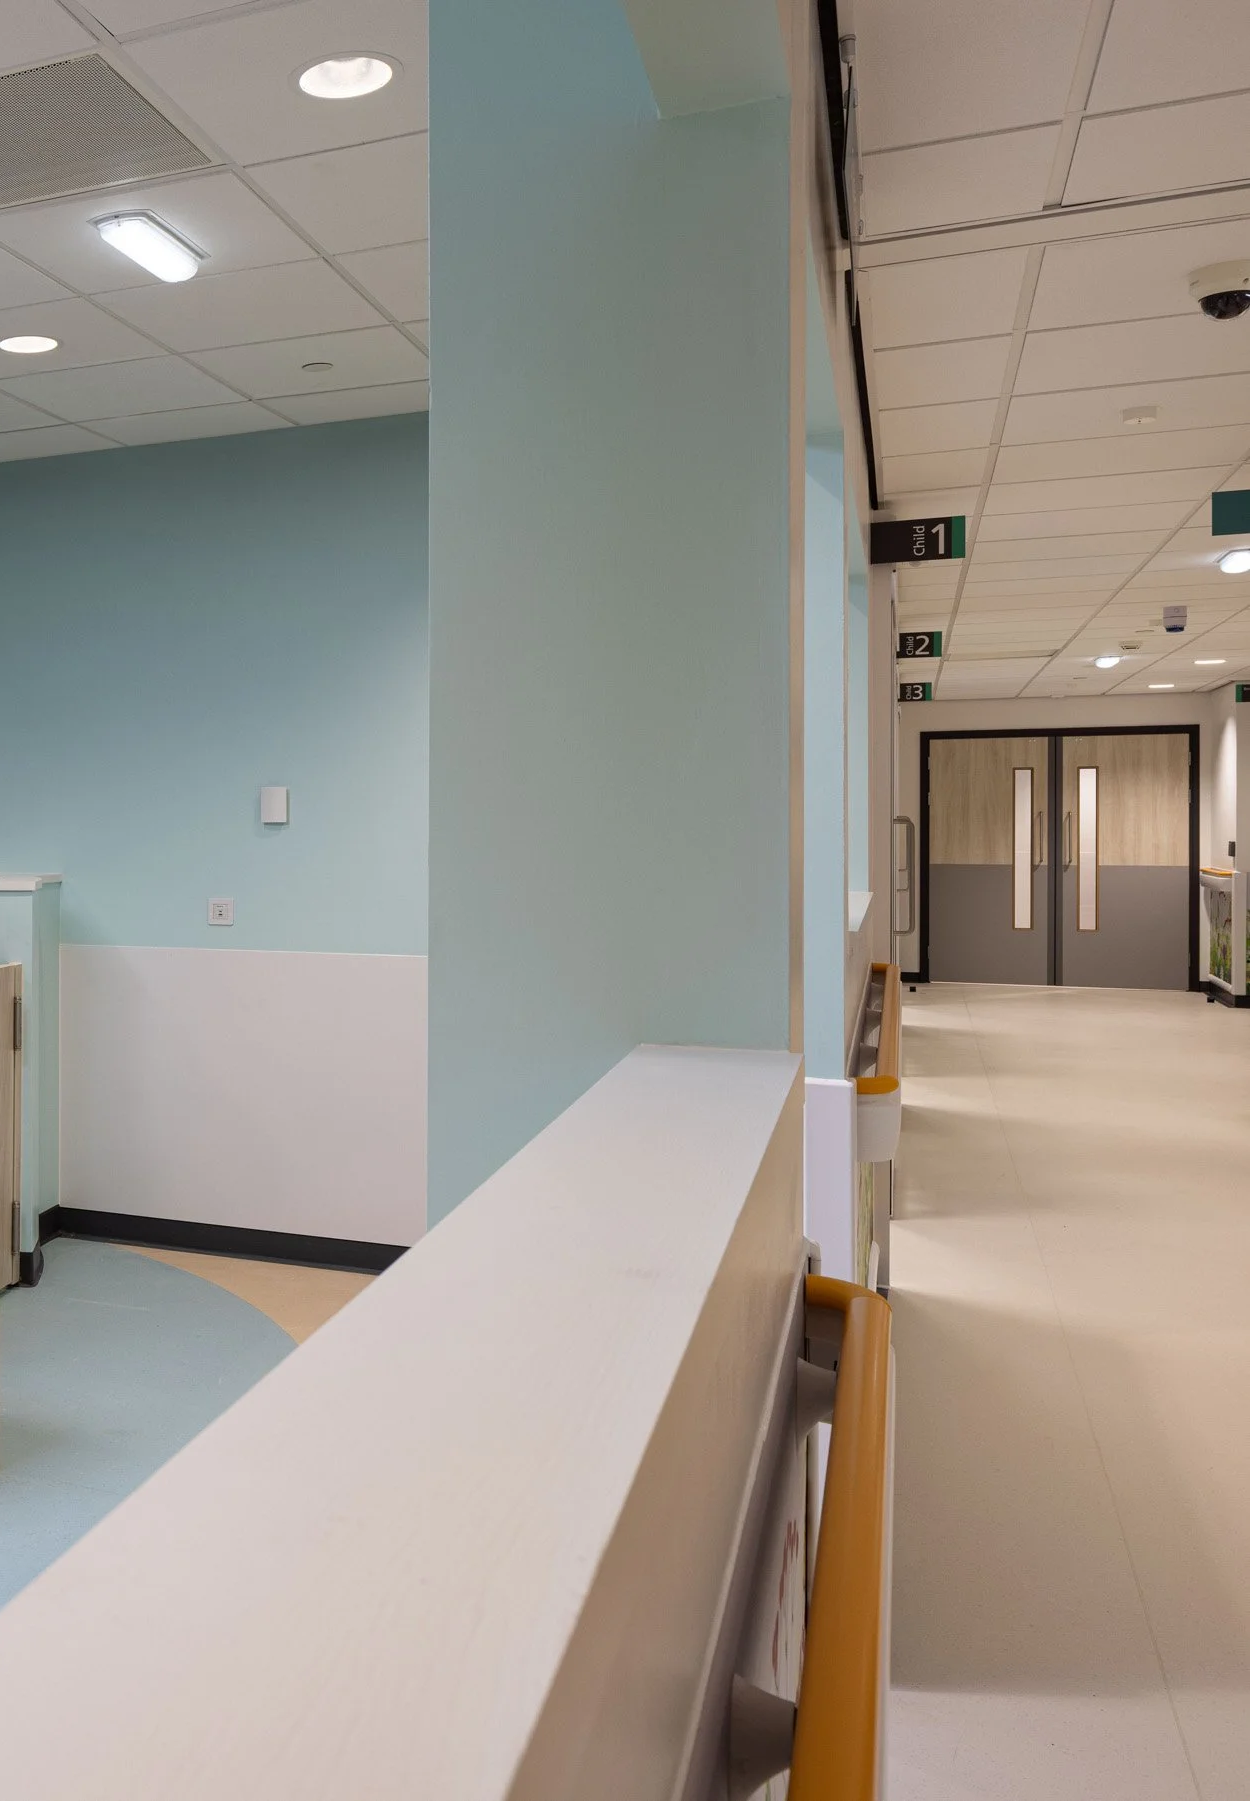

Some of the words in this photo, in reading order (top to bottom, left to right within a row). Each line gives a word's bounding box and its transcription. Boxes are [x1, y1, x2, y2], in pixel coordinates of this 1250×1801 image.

[913, 525, 925, 556] Child
[931, 523, 945, 555] 1
[906, 636, 914, 655] Child
[915, 635, 929, 655] 2
[912, 684, 923, 700] 3
